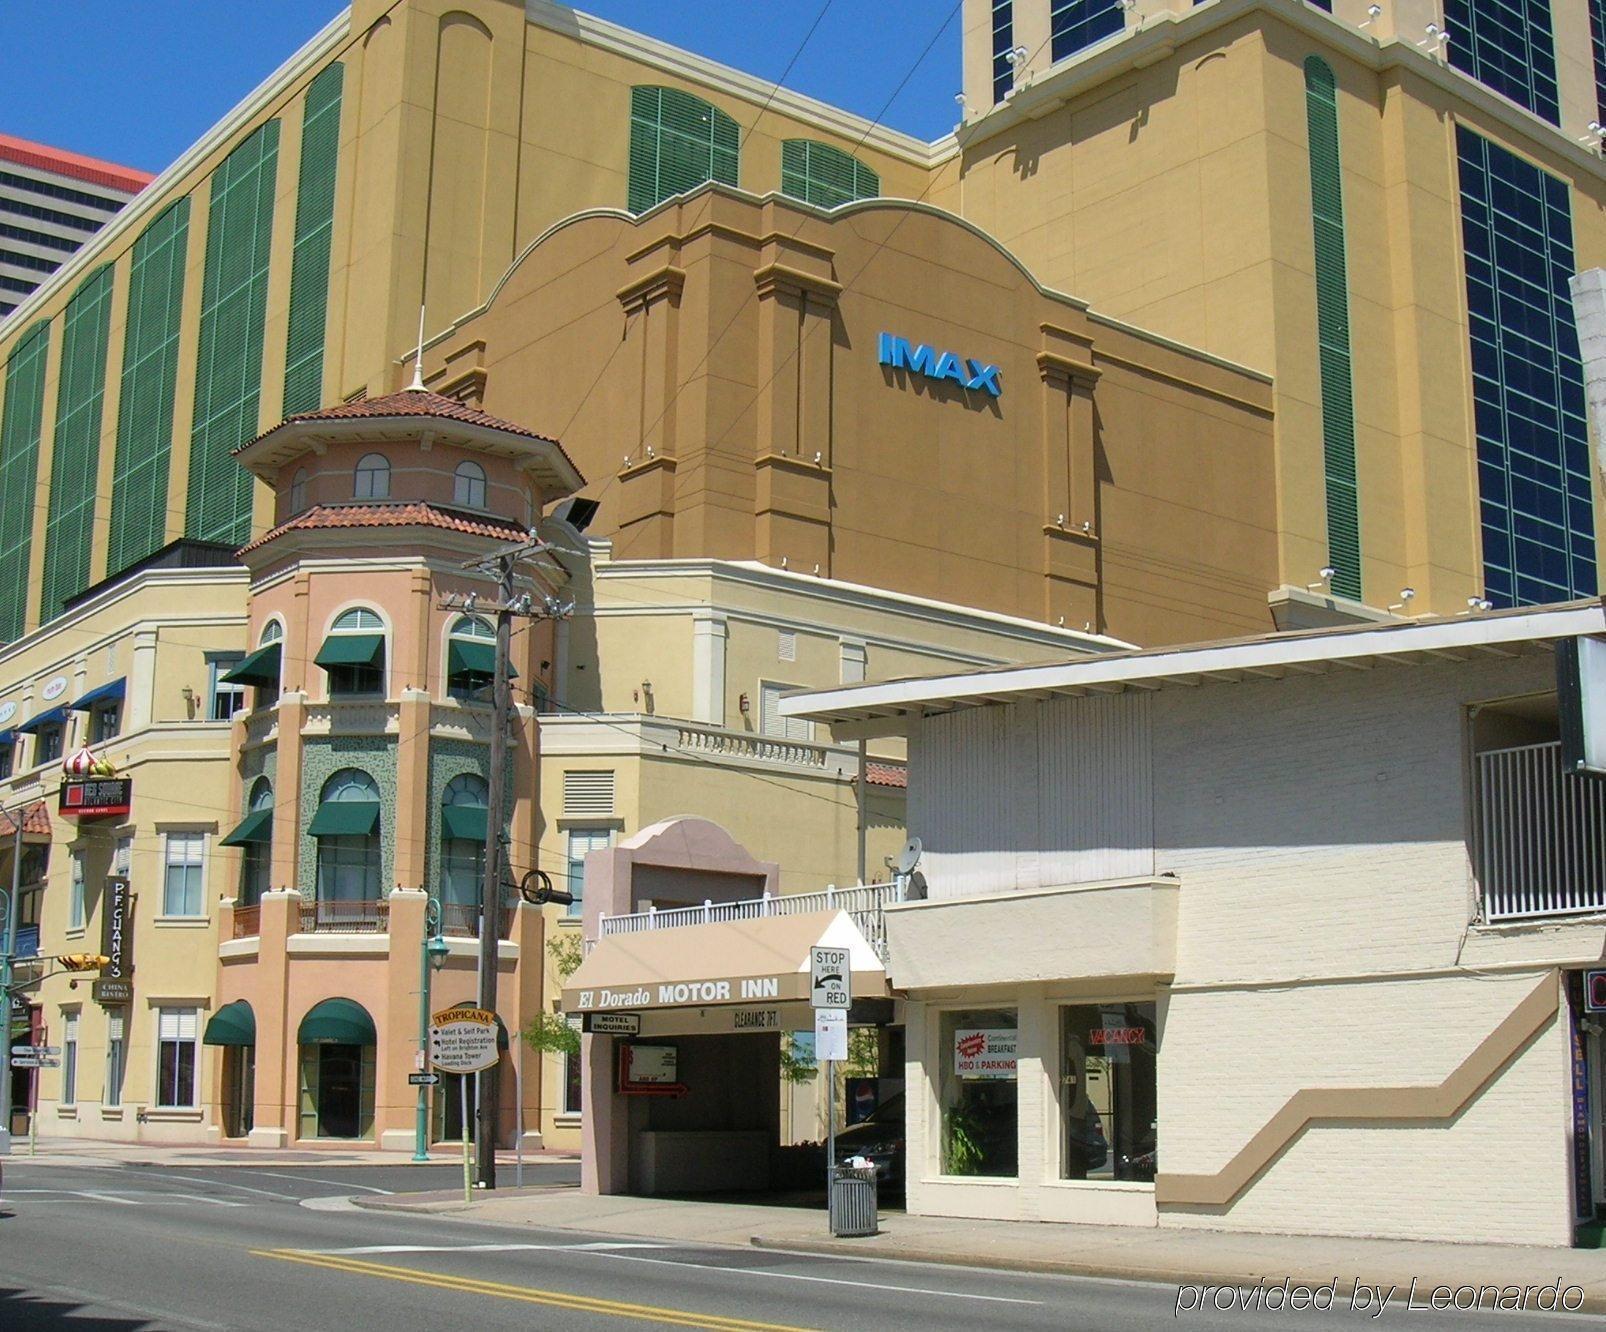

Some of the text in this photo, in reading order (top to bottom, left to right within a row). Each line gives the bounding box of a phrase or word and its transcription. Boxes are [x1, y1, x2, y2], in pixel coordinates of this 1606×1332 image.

[878, 331, 1003, 398] IMAX
[816, 951, 845, 965] STOP
[821, 965, 840, 974] HERE
[102, 983, 128, 991] CHINA
[831, 982, 841, 990] ON
[577, 978, 779, 1009] El Dorado MOTOR INN
[826, 991, 847, 1004] RED
[435, 1010, 489, 1024] TROPICANA
[601, 1015, 629, 1023] MOTEL
[734, 1011, 765, 1028] CLEARANCE
[593, 1023, 637, 1031] INQUIRIES
[458, 1037, 495, 1045] Registration
[1089, 1027, 1145, 1045] VACANCY
[987, 1044, 1017, 1054] BREAKFAST
[958, 1060, 974, 1070] HBO
[981, 1059, 1017, 1070] PARKING
